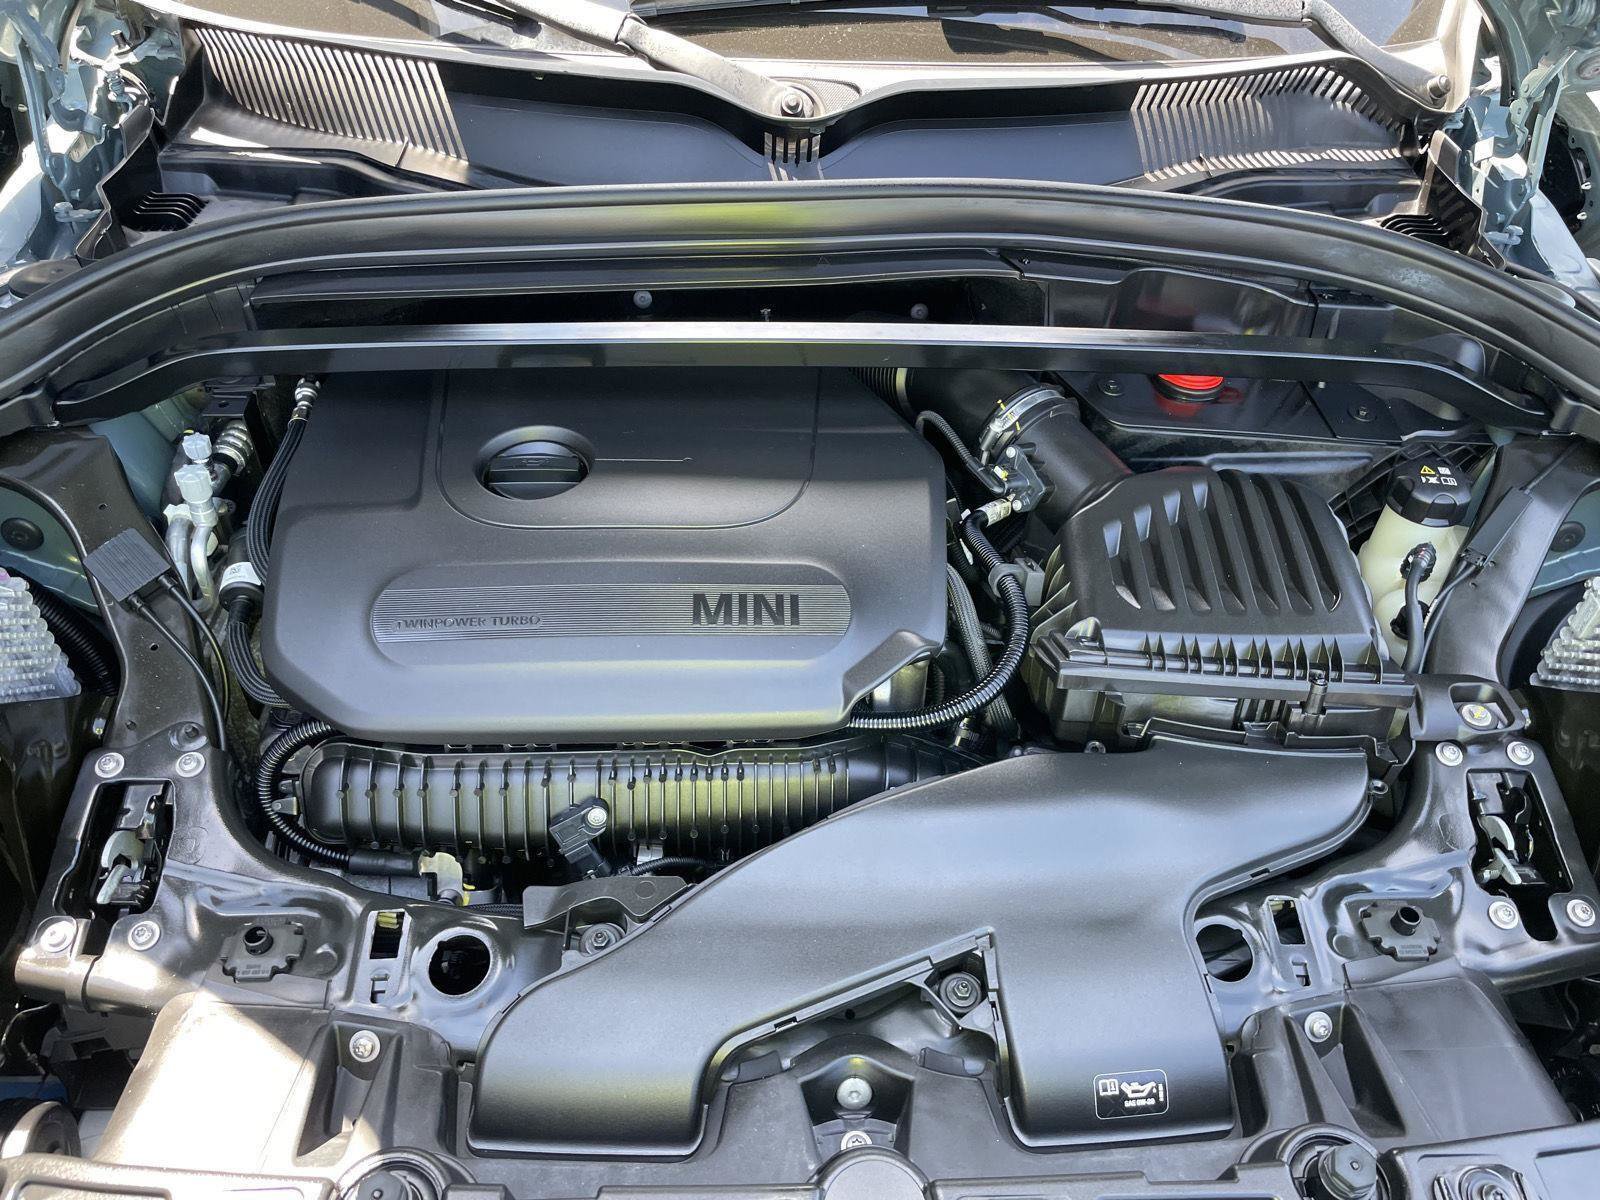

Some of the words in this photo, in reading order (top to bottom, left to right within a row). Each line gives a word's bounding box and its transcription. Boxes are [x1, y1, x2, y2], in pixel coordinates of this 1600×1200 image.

[692, 593, 799, 626] MINI
[397, 616, 486, 629] TWINPOWER
[491, 615, 541, 626] TURBO
